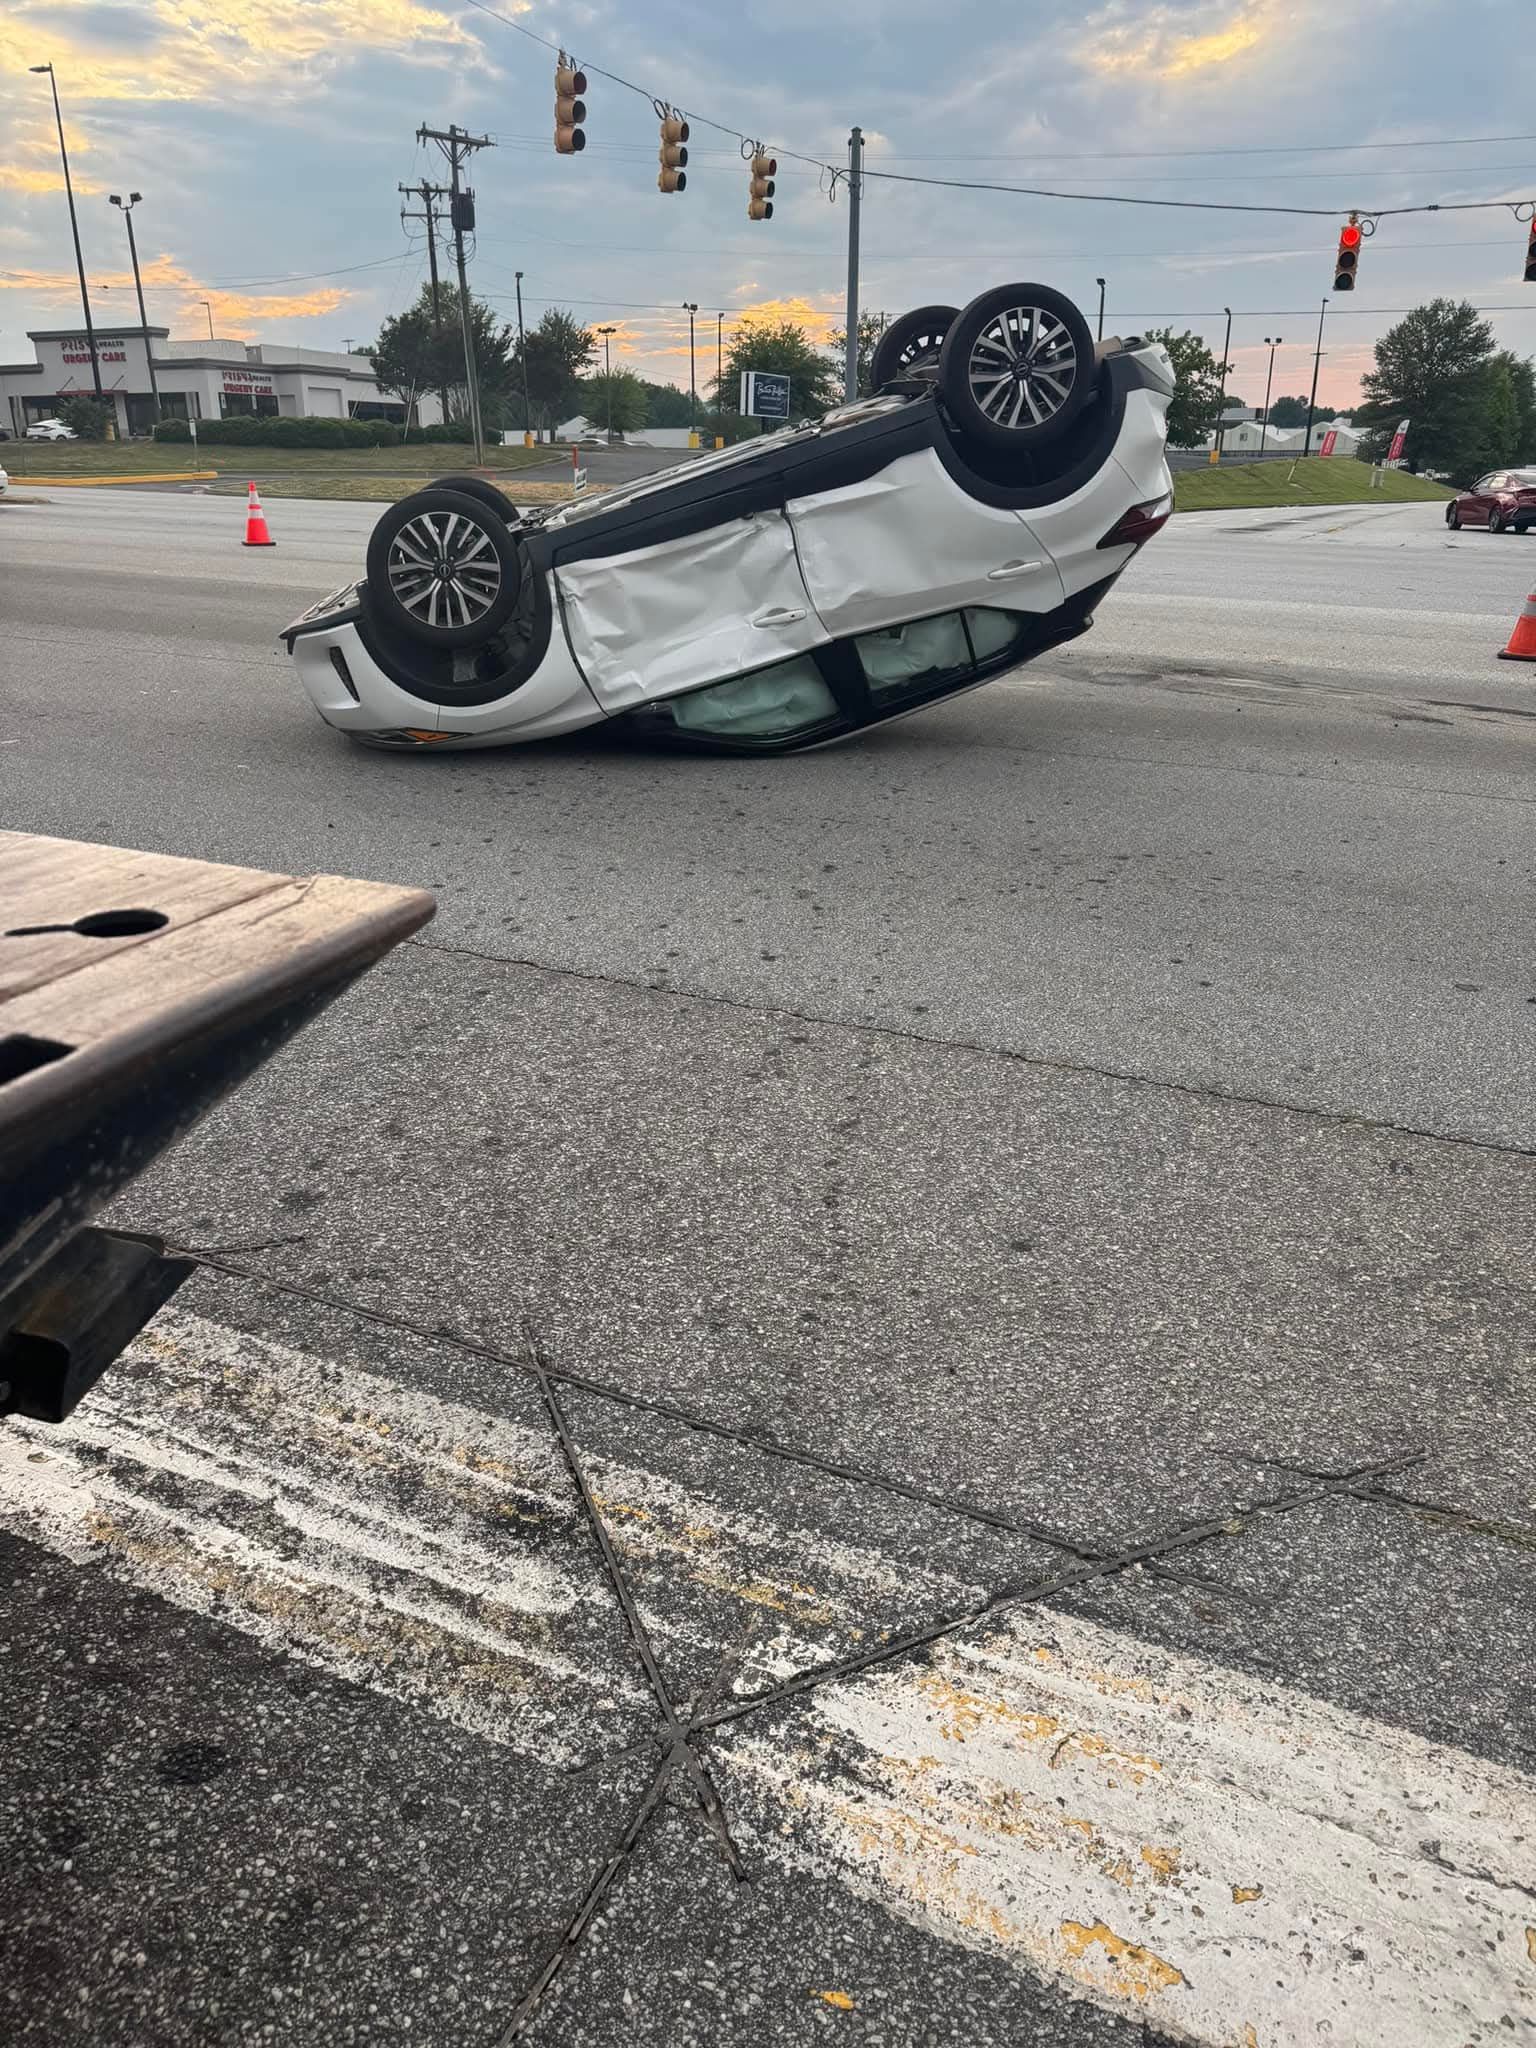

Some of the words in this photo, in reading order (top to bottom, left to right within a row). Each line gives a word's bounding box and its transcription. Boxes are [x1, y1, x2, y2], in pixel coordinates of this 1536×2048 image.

[61, 340, 98, 351] PRISA
[102, 352, 126, 362] CARE
[223, 383, 253, 393] URGENT
[255, 386, 272, 394] CARE
